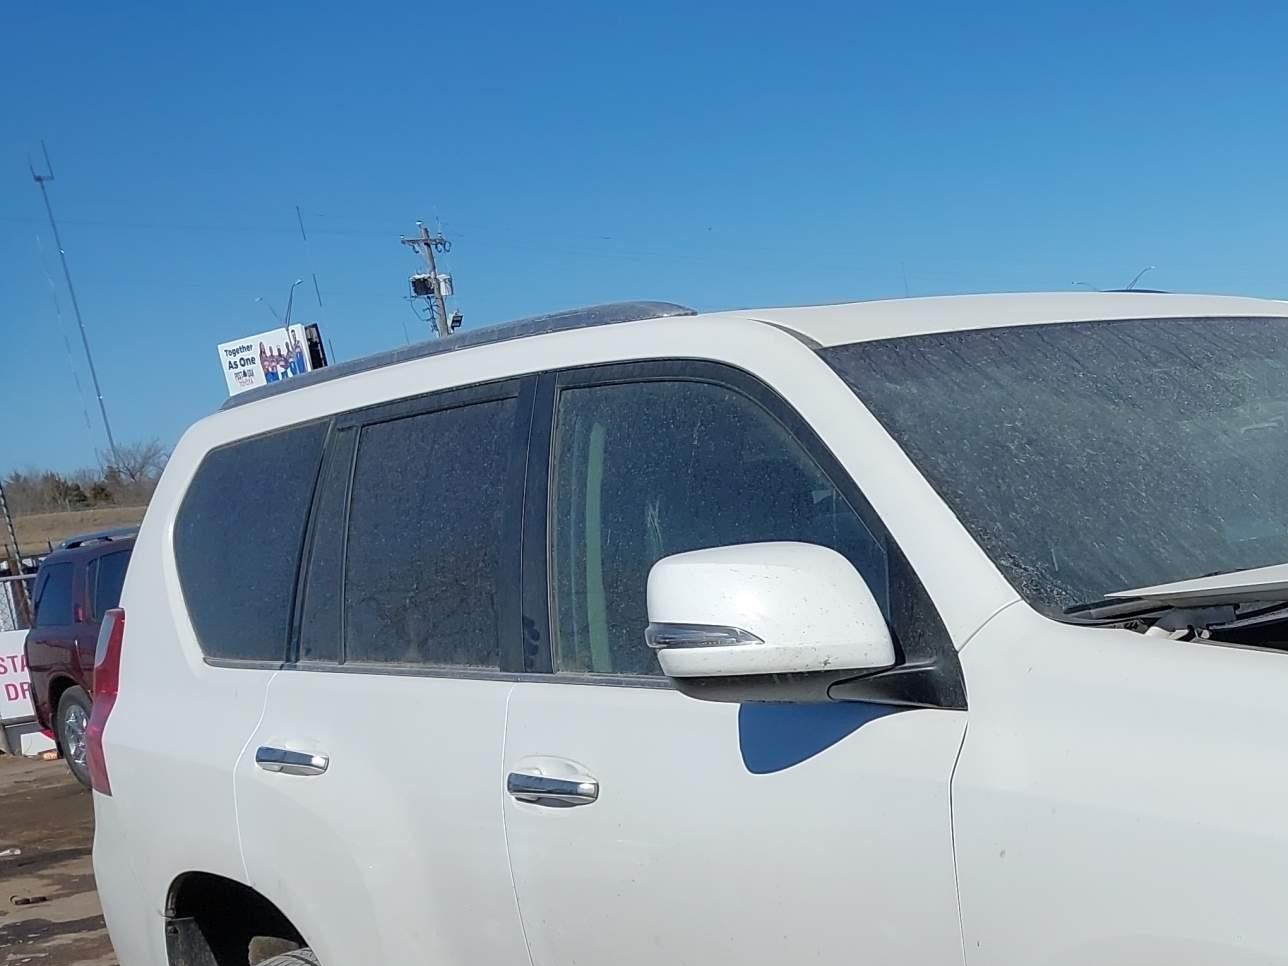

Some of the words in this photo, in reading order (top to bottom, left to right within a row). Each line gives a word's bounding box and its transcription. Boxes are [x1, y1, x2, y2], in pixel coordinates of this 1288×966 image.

[224, 344, 253, 358] Together
[228, 360, 239, 371] As
[239, 356, 256, 368] One
